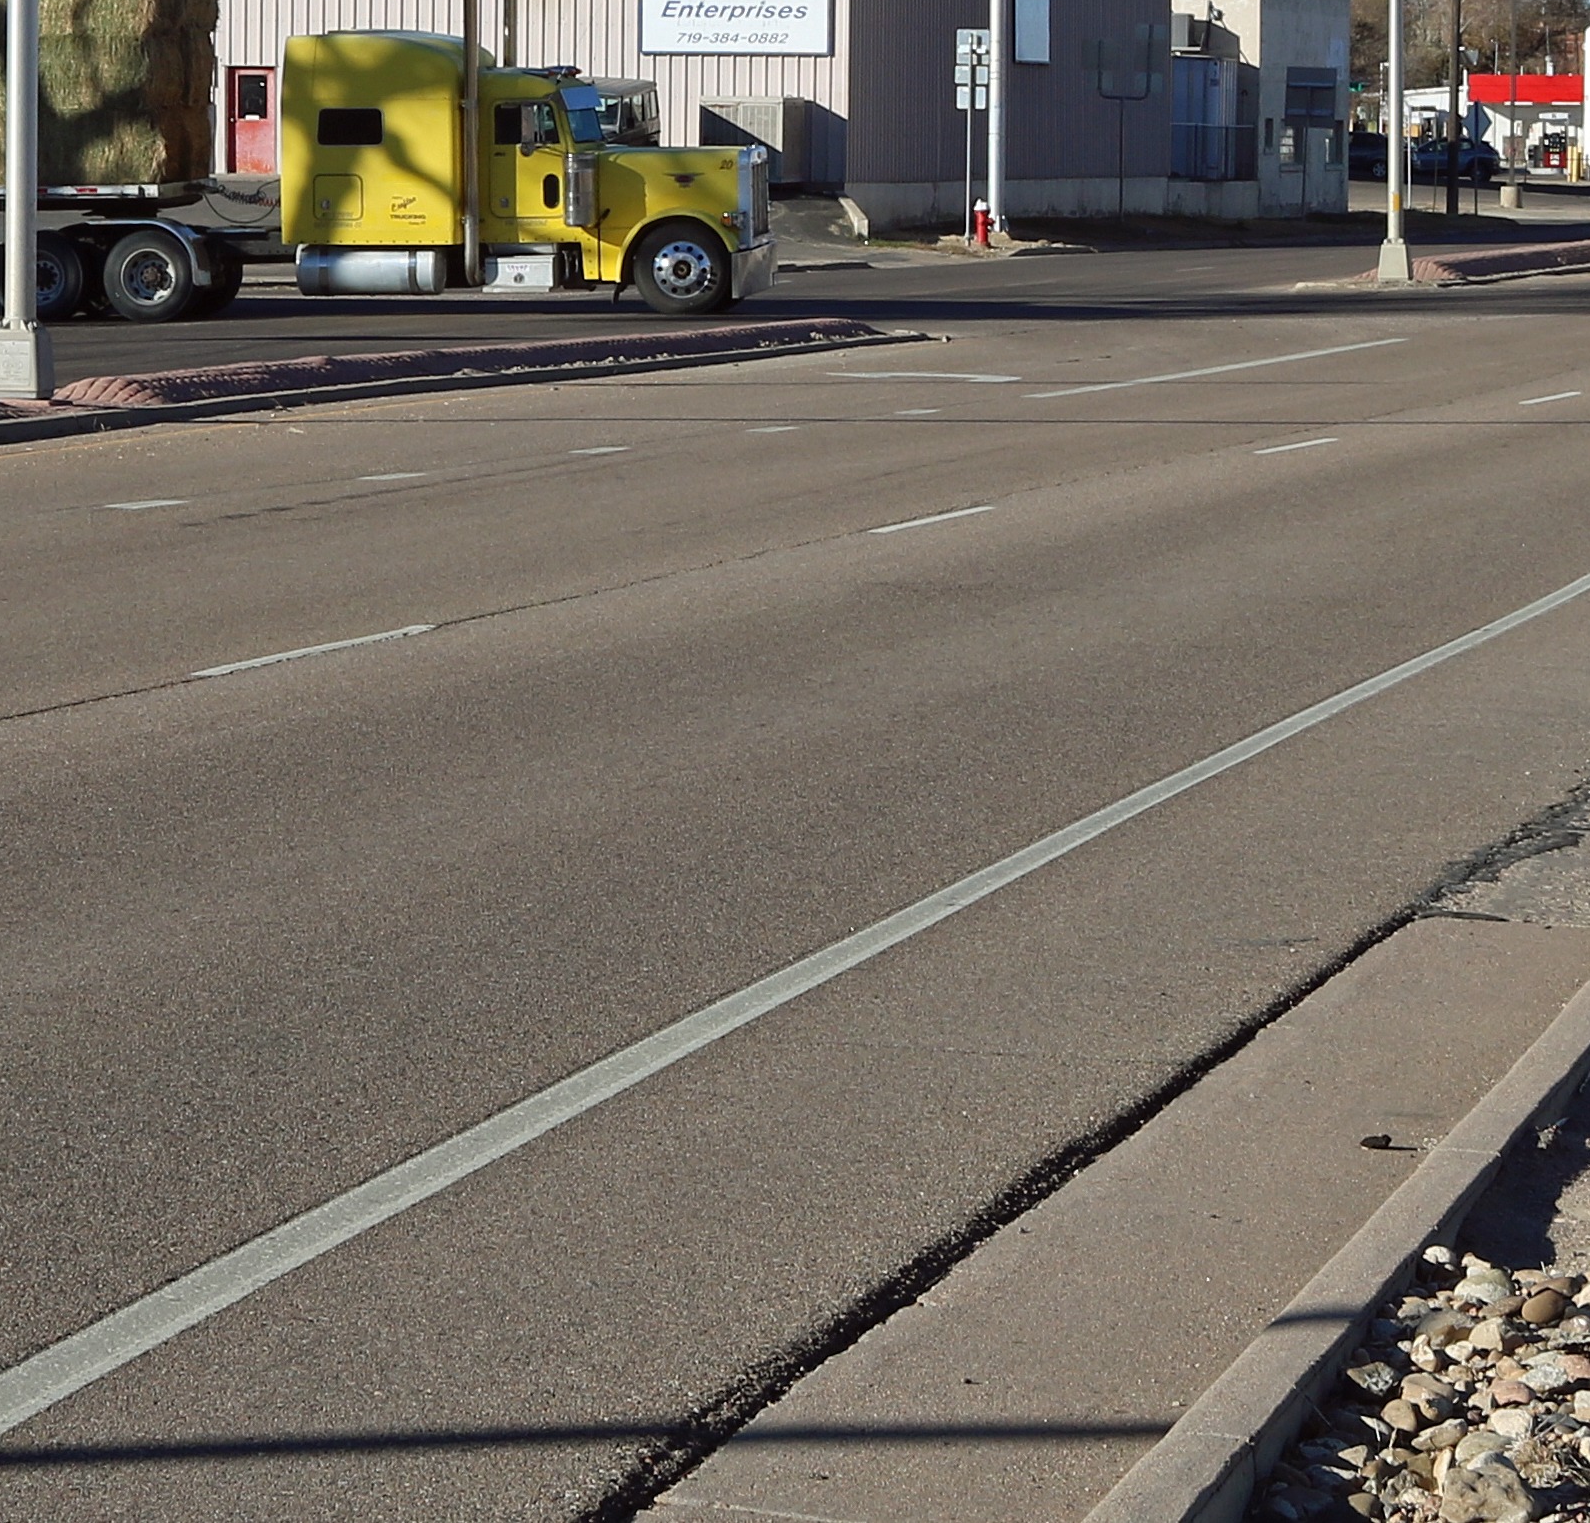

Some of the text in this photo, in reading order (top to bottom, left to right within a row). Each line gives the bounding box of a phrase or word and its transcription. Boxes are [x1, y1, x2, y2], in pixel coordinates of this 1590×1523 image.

[660, 0, 809, 22] Enterprises
[676, 32, 789, 44] 719-384-0882
[719, 160, 734, 170] 20
